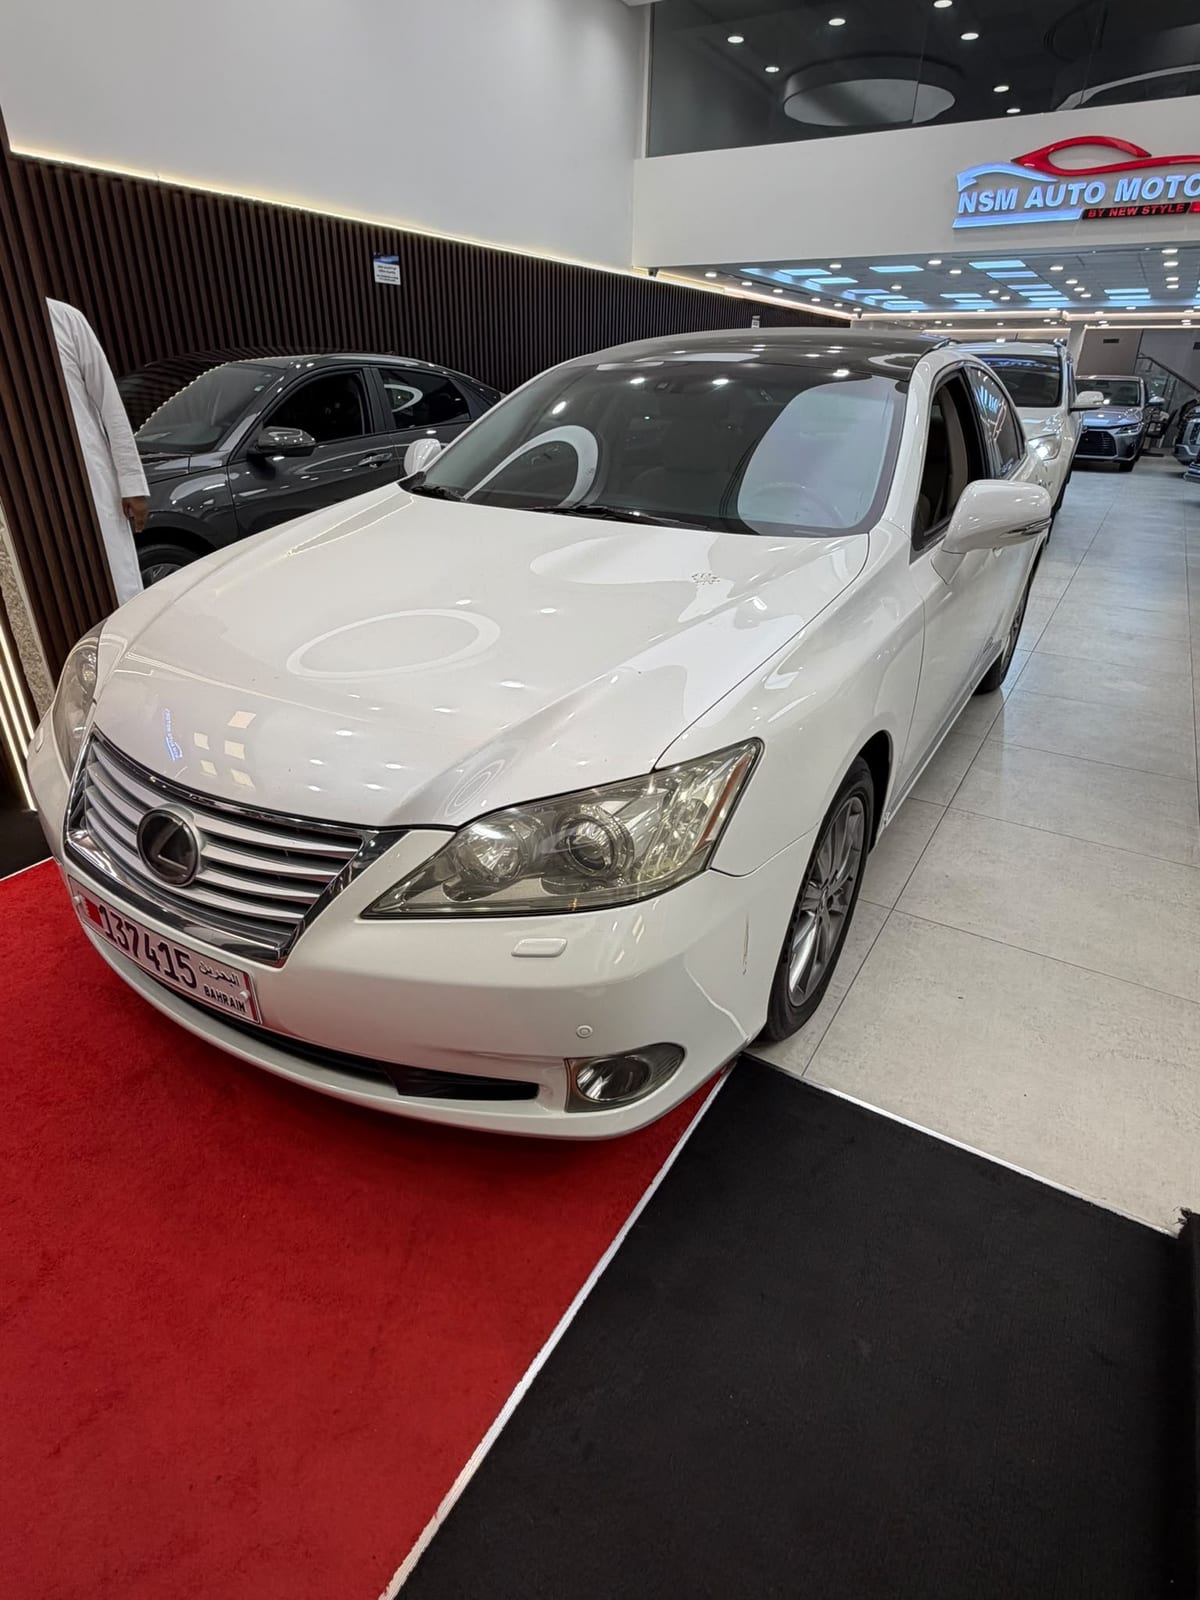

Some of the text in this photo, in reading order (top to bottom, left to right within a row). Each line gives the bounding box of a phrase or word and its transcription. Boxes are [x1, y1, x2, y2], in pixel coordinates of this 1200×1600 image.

[958, 190, 1018, 213] NSM
[1024, 181, 1106, 209] AUTO
[1088, 203, 1185, 218] BY NEW STYLE
[98, 904, 198, 989] 137415
[199, 960, 240, 988] البحرين
[204, 985, 246, 1013] BAHRAIN
